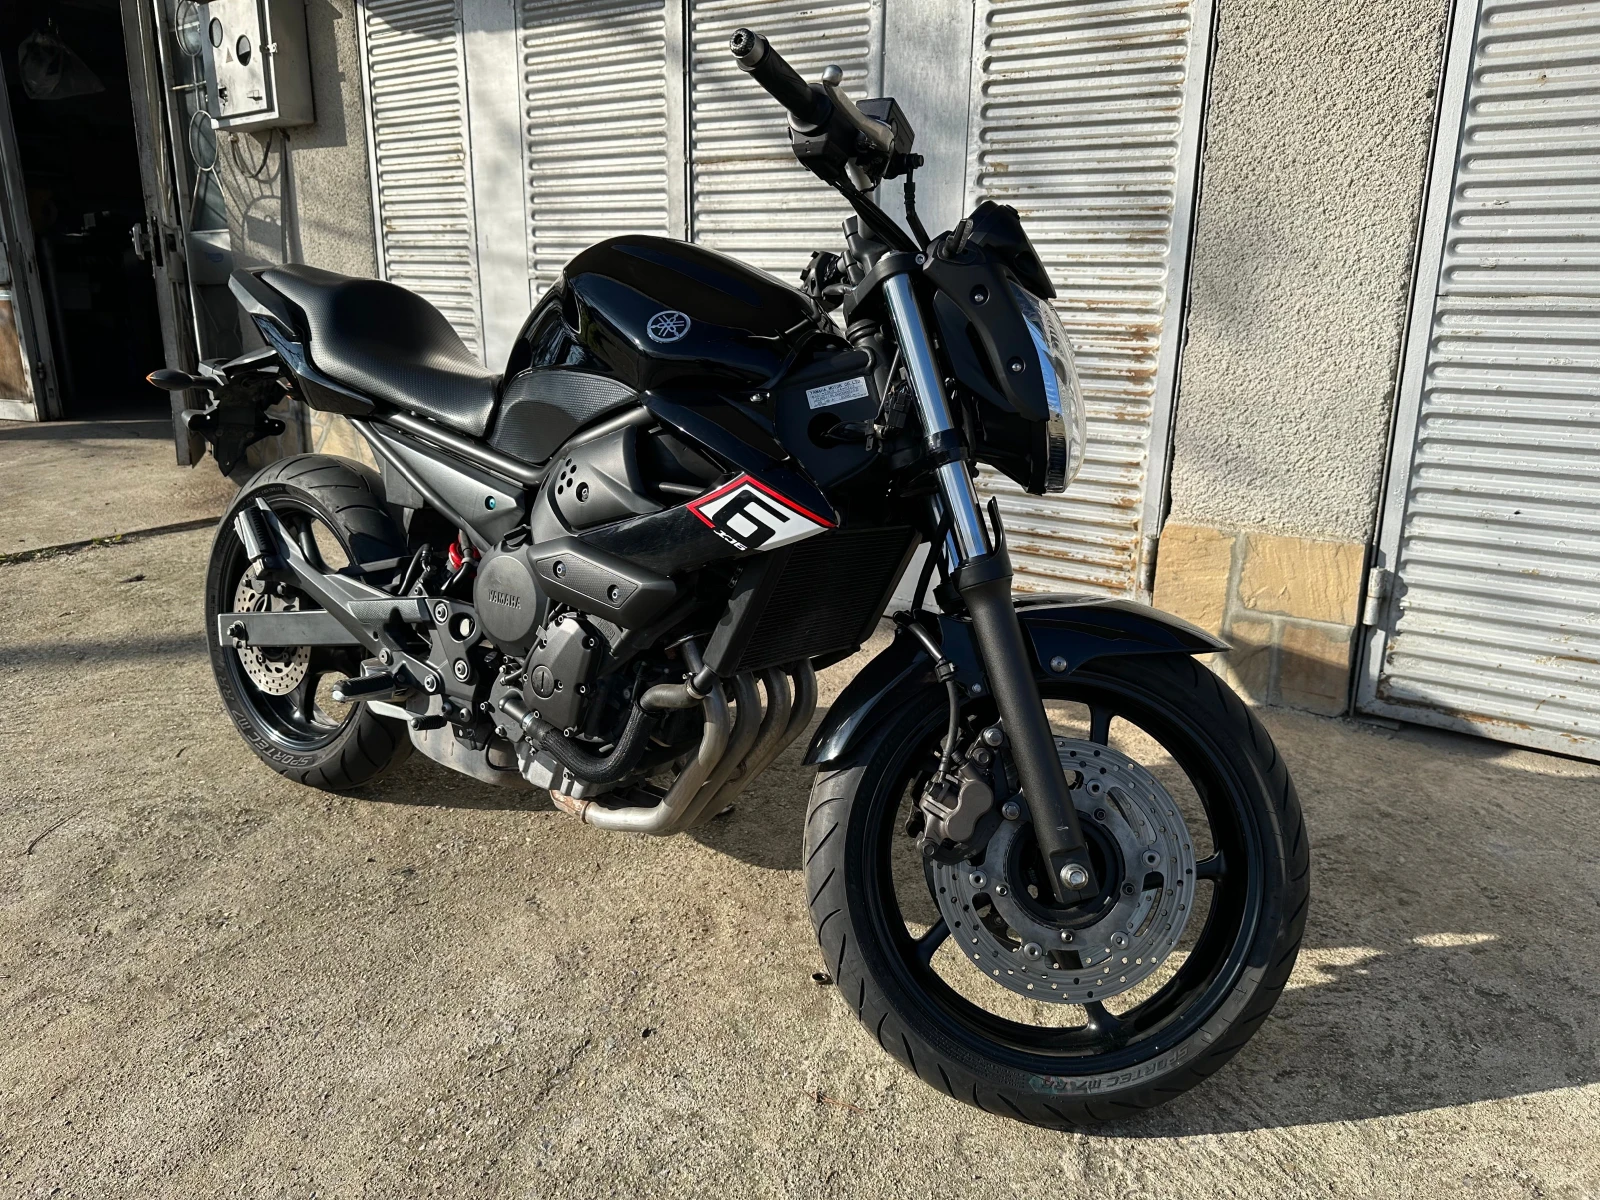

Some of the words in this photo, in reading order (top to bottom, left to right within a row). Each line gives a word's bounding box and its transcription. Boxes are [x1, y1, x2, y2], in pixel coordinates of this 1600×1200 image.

[712, 489, 790, 549] 6
[713, 529, 748, 551] XJ6
[488, 589, 522, 610] YAMAHA
[217, 675, 236, 702] RR
[247, 731, 313, 766] SPORTEC
[1106, 1043, 1190, 1088] SPORTEC
